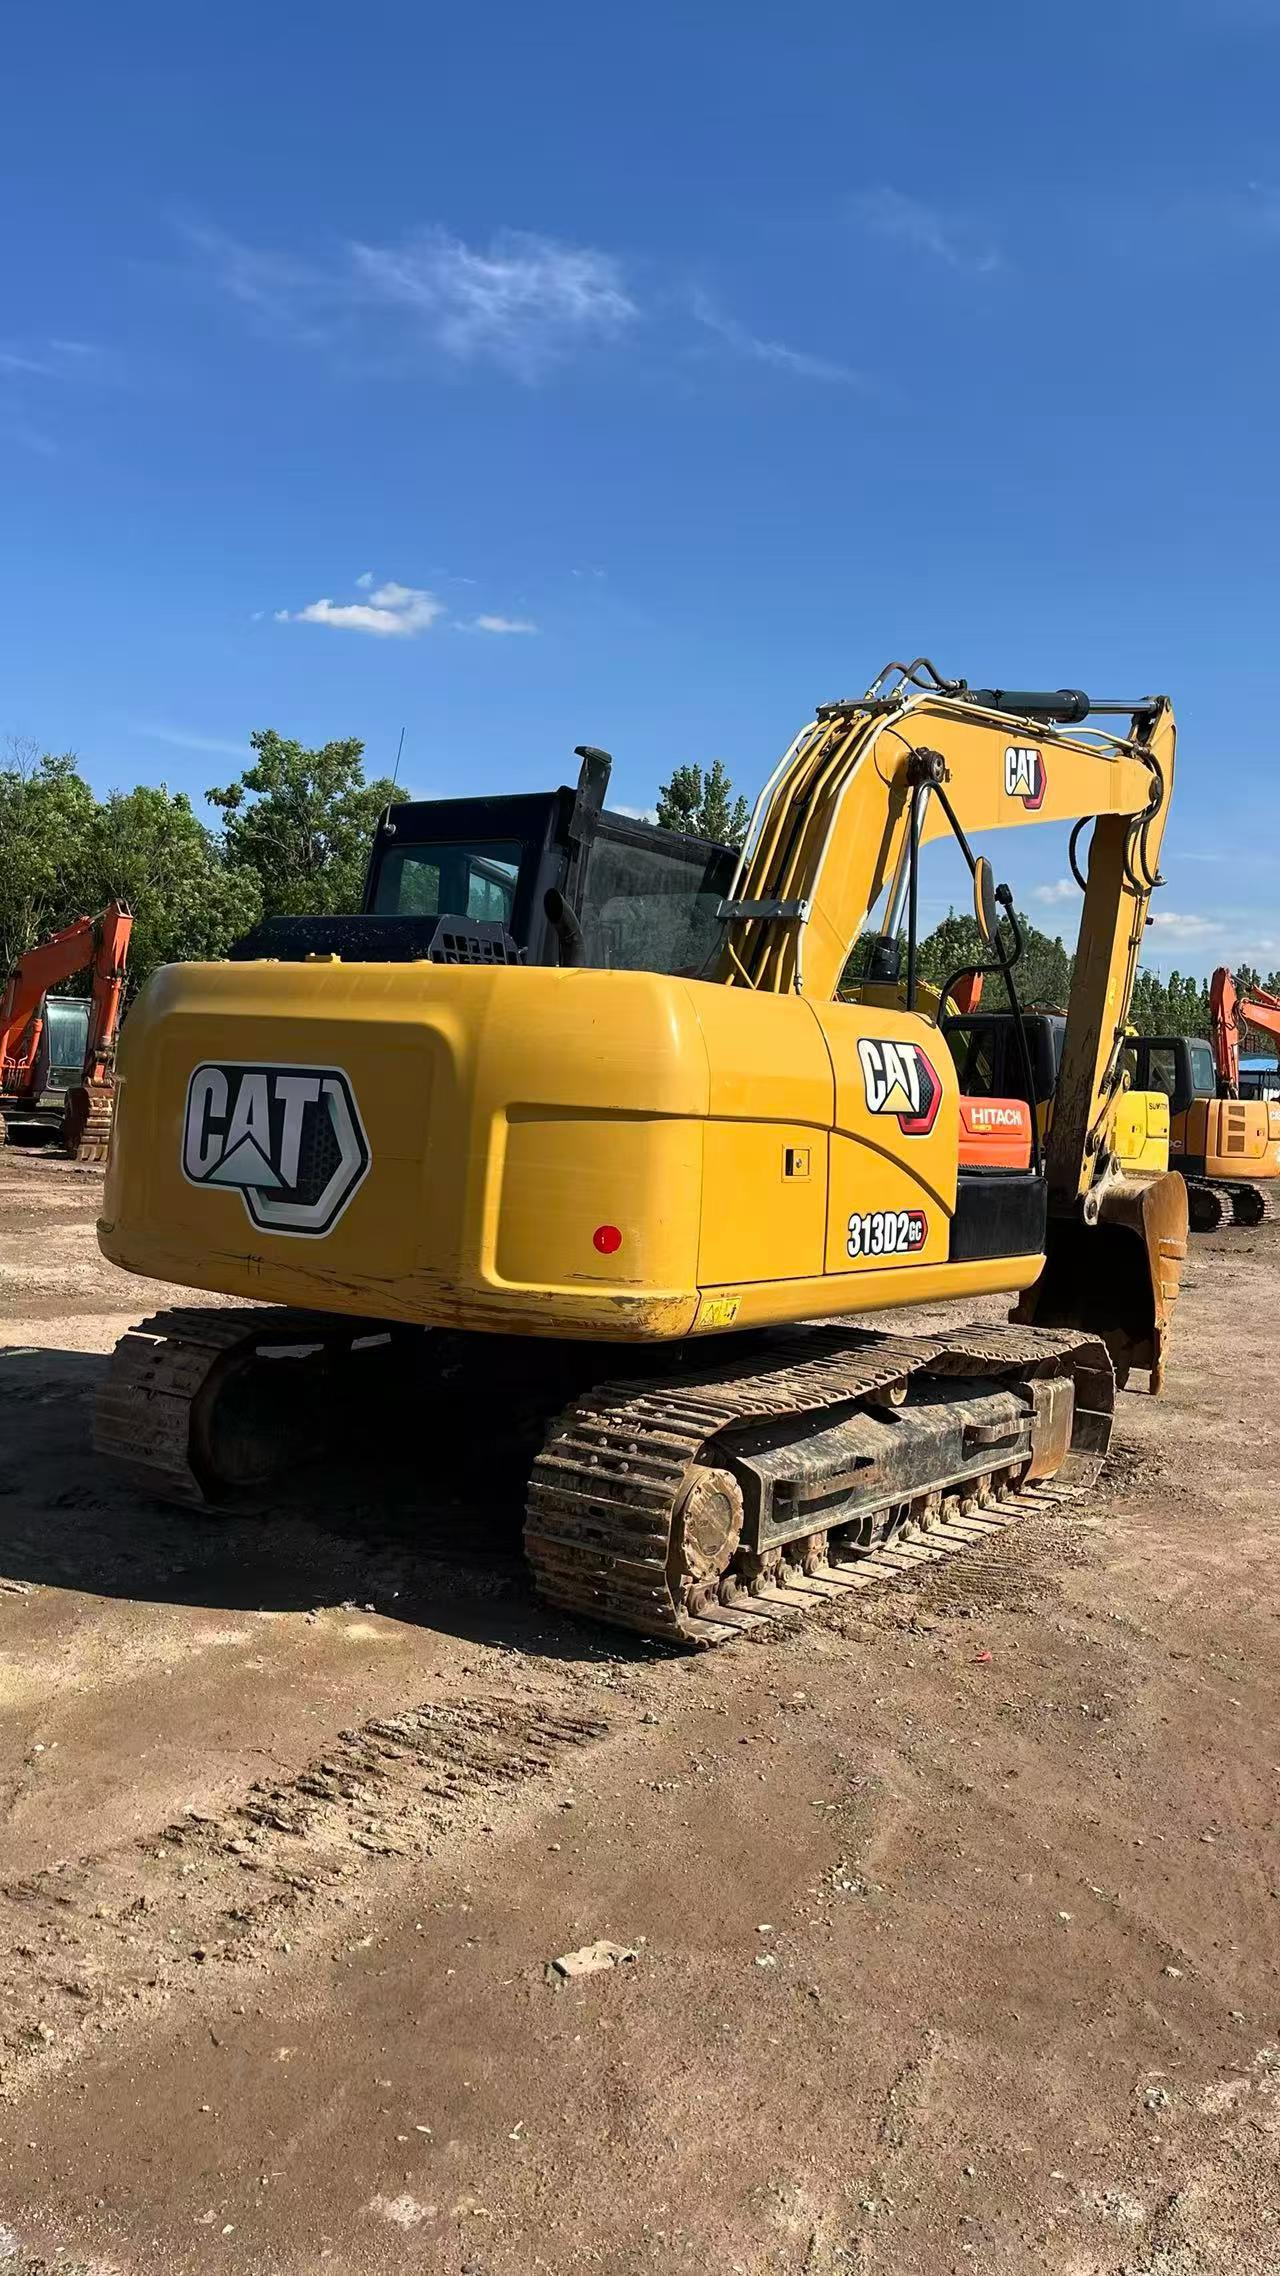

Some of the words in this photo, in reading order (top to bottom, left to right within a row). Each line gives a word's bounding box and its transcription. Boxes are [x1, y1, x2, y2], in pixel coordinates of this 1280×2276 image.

[1005, 747, 1037, 795] CAT
[858, 1040, 918, 1111] CAT
[187, 1068, 320, 1188] CAT
